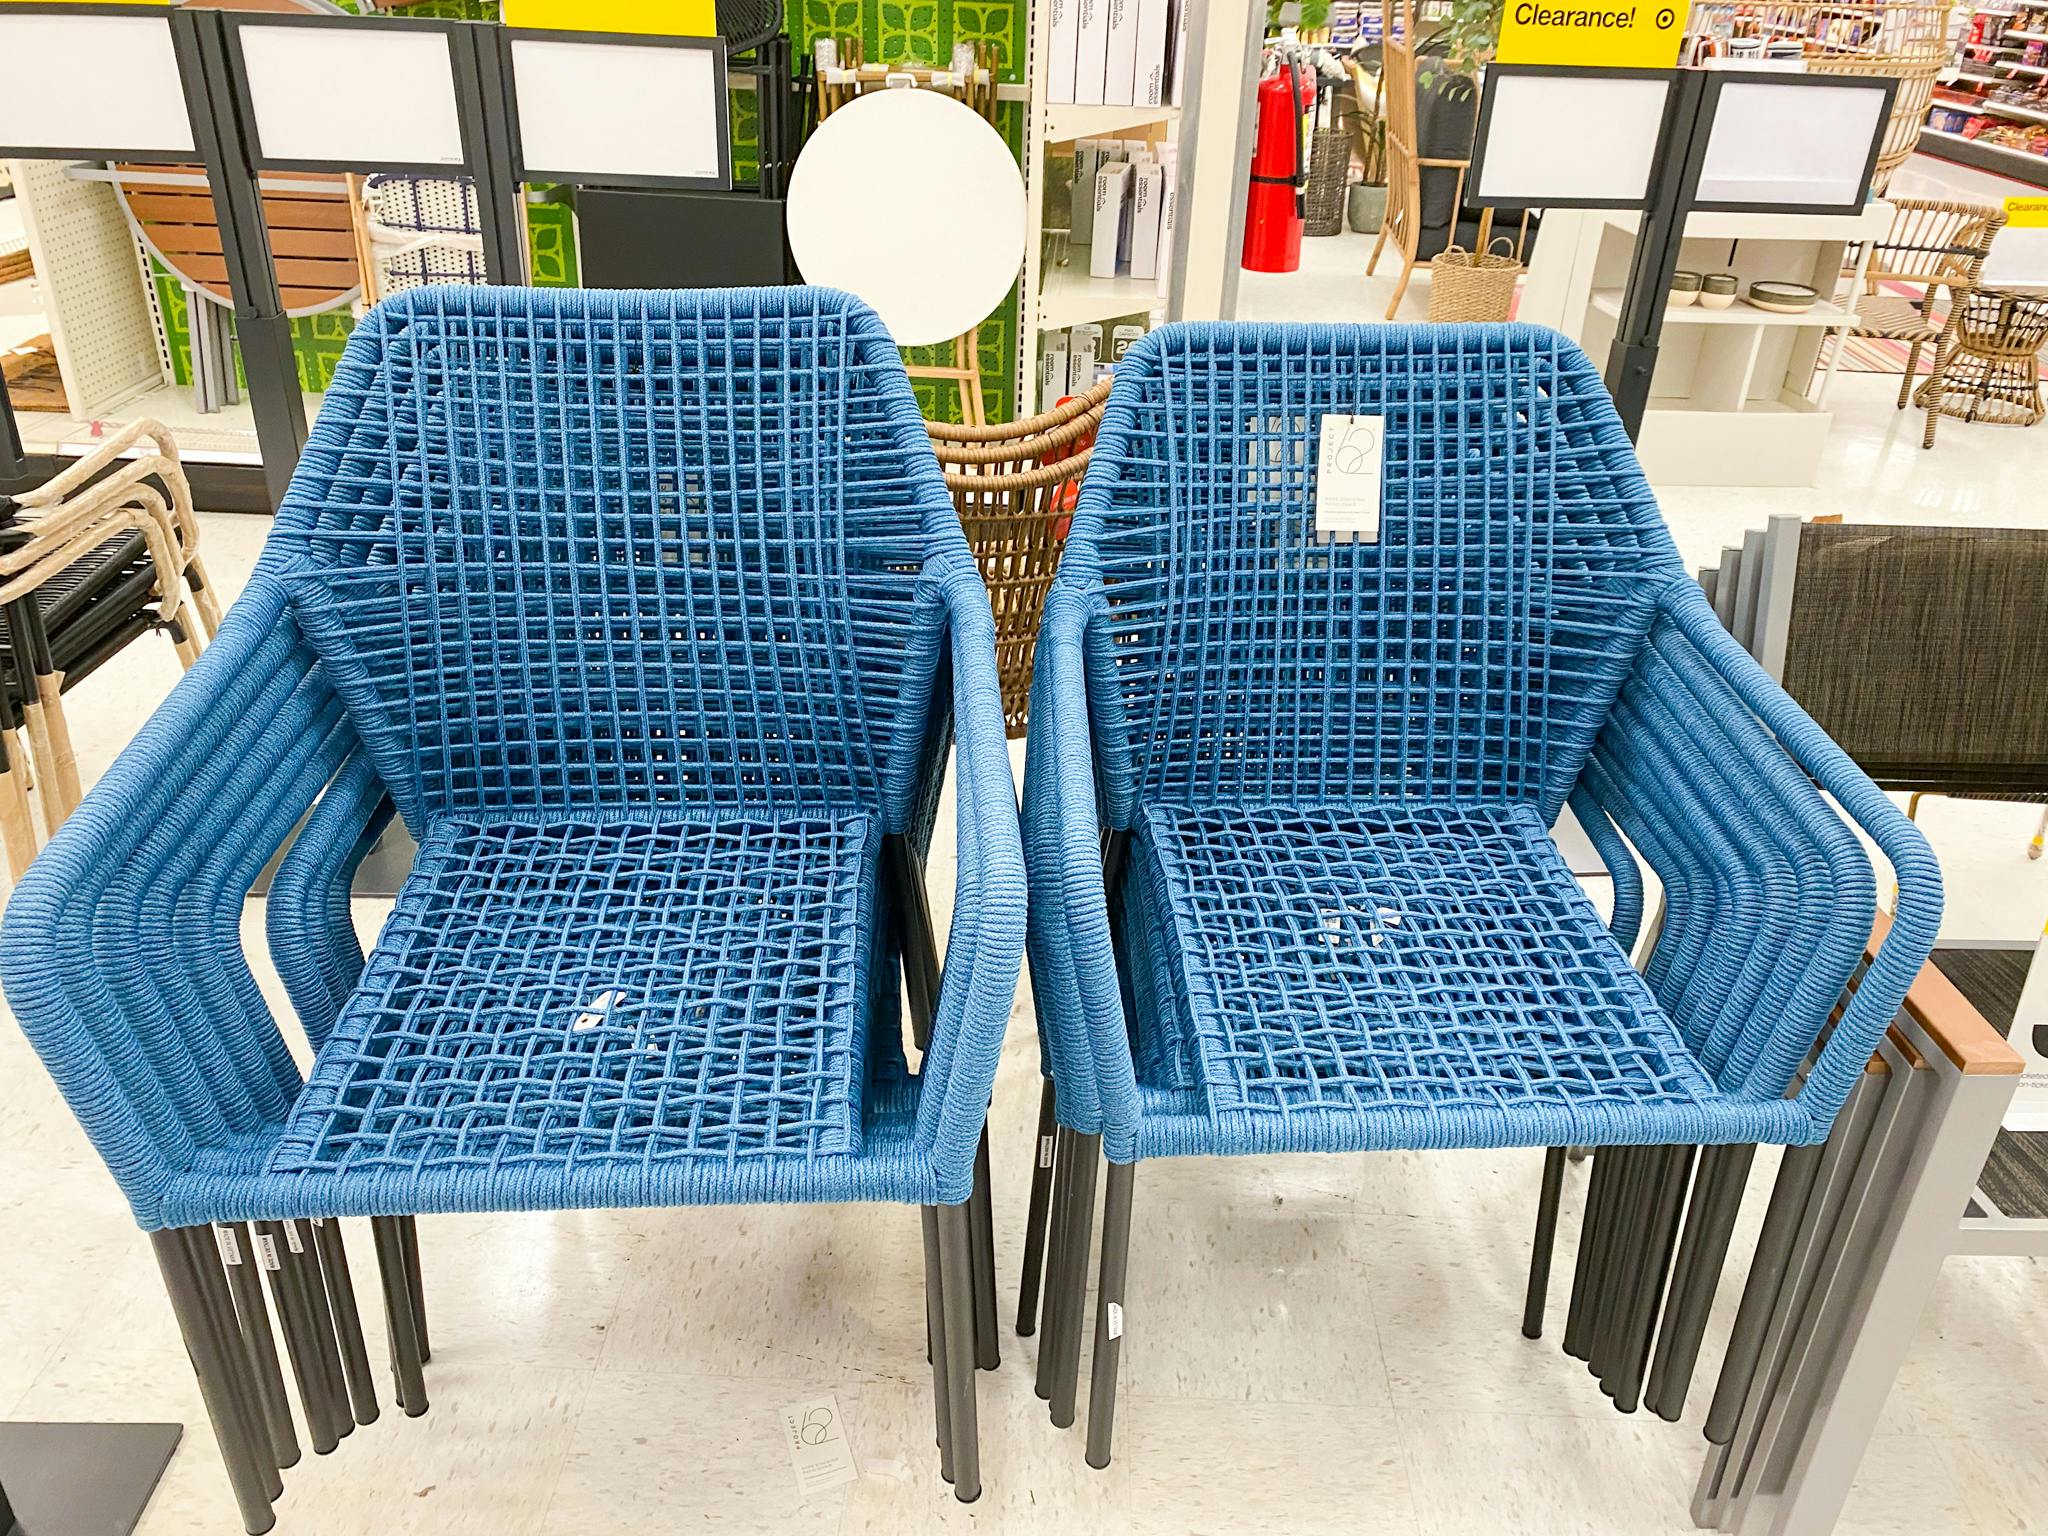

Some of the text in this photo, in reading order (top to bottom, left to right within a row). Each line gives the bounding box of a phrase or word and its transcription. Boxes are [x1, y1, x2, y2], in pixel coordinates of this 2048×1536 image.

[1515, 3, 1636, 28] Clearance!
[1153, 64, 1161, 105] essentials
[1136, 177, 1145, 214] essentials
[1326, 427, 1335, 474] PROJECT
